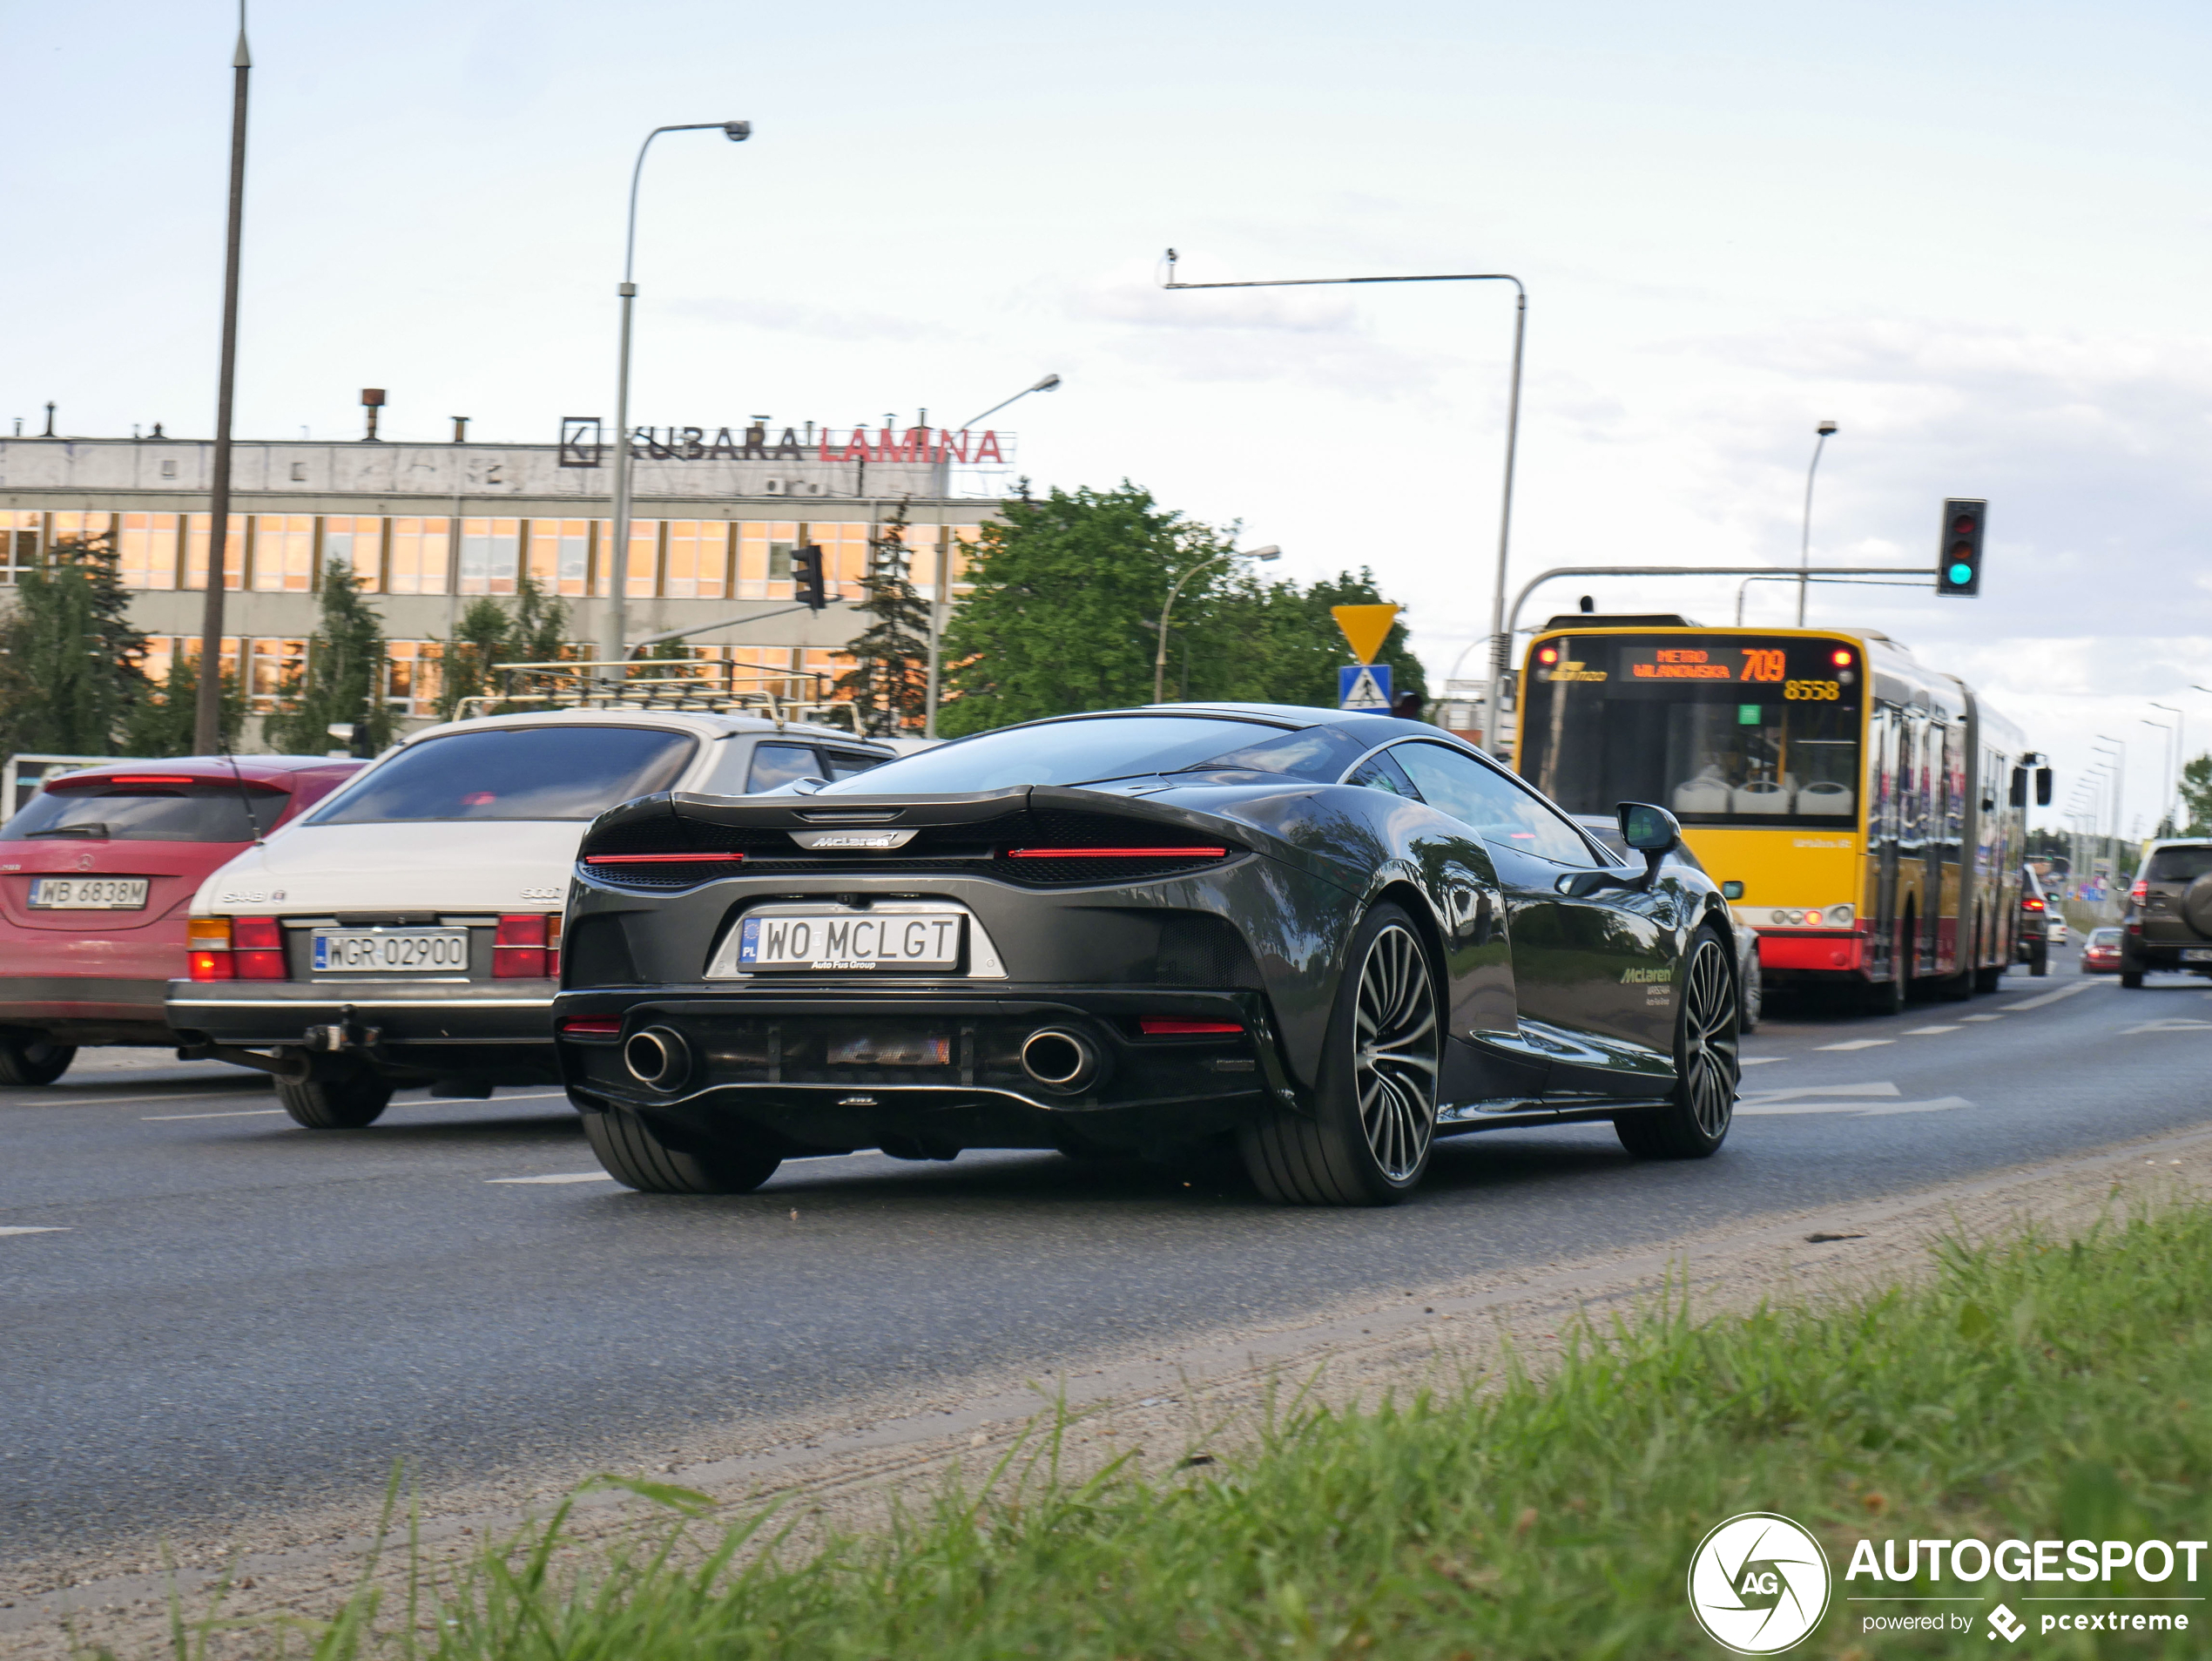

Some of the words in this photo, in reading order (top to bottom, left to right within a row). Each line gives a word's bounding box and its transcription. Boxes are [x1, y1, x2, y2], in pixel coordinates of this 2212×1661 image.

[819, 428, 1003, 463] LAMINA
[1740, 649, 1786, 681] 709
[1784, 679, 1840, 700] 8558
[812, 837, 889, 847] McLaren
[44, 881, 71, 901] WB
[78, 881, 144, 901] 6838M
[743, 946, 756, 958] PL
[767, 922, 811, 959] WO
[826, 921, 953, 959] MCLGT
[329, 938, 377, 966] WGR
[385, 938, 462, 965] 02900
[812, 961, 833, 969] Auto
[833, 961, 849, 969] Fus
[850, 961, 876, 970] Group
[1620, 968, 1671, 983] McLaren
